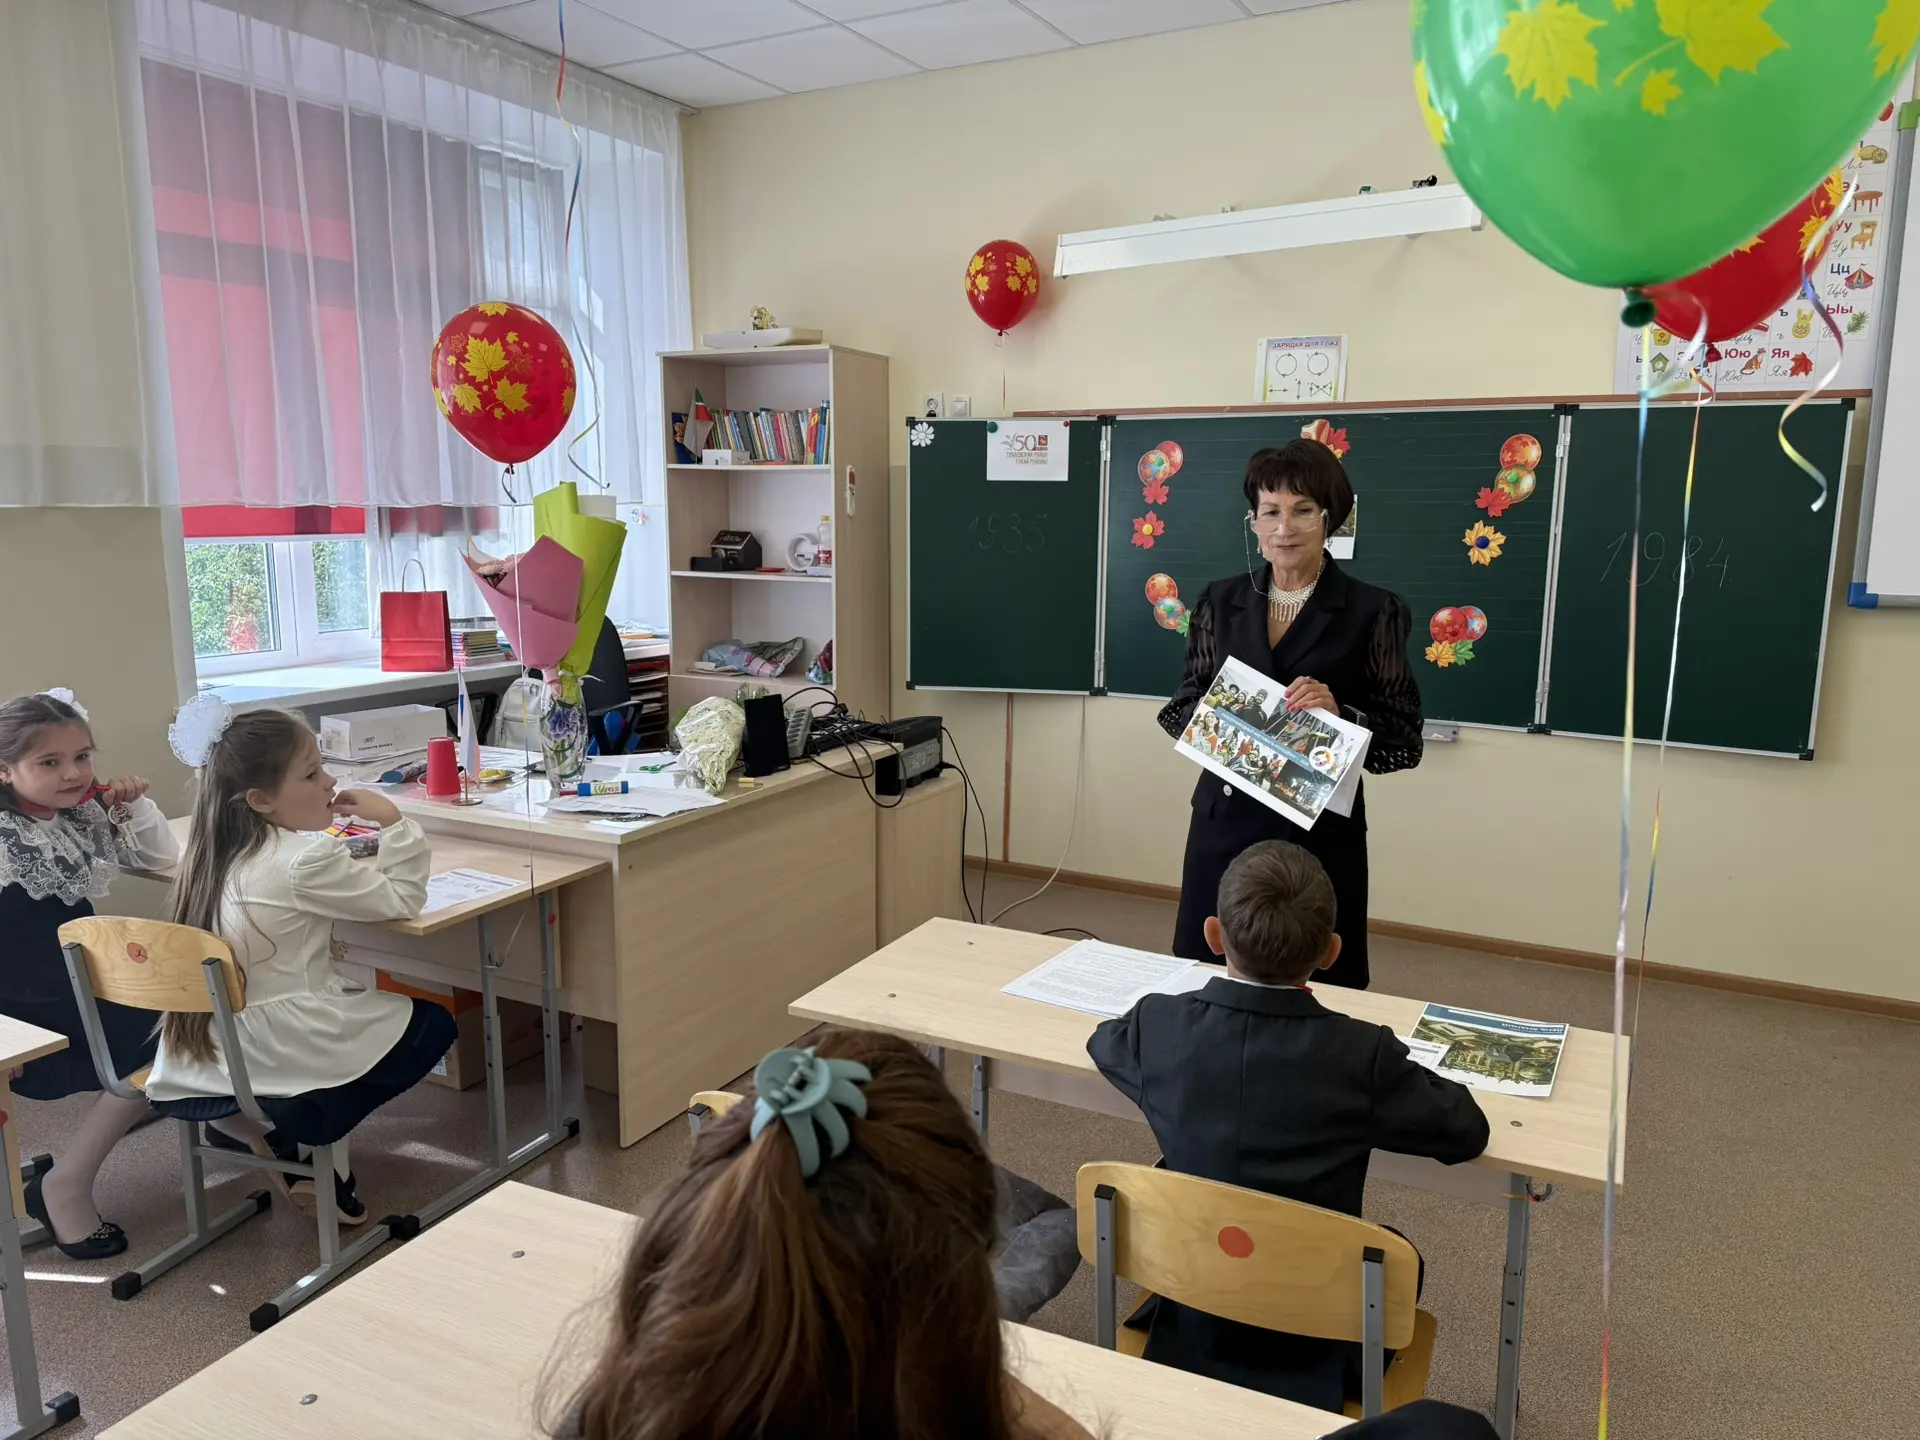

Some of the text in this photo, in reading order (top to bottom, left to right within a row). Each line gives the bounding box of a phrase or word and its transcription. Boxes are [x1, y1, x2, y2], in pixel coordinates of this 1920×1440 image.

[1830, 263, 1850, 275] Цц
[1826, 303, 1853, 315] Ыы
[1724, 348, 1751, 359] Юю
[1771, 348, 1790, 358] Яя
[1014, 434, 1037, 451] 50
